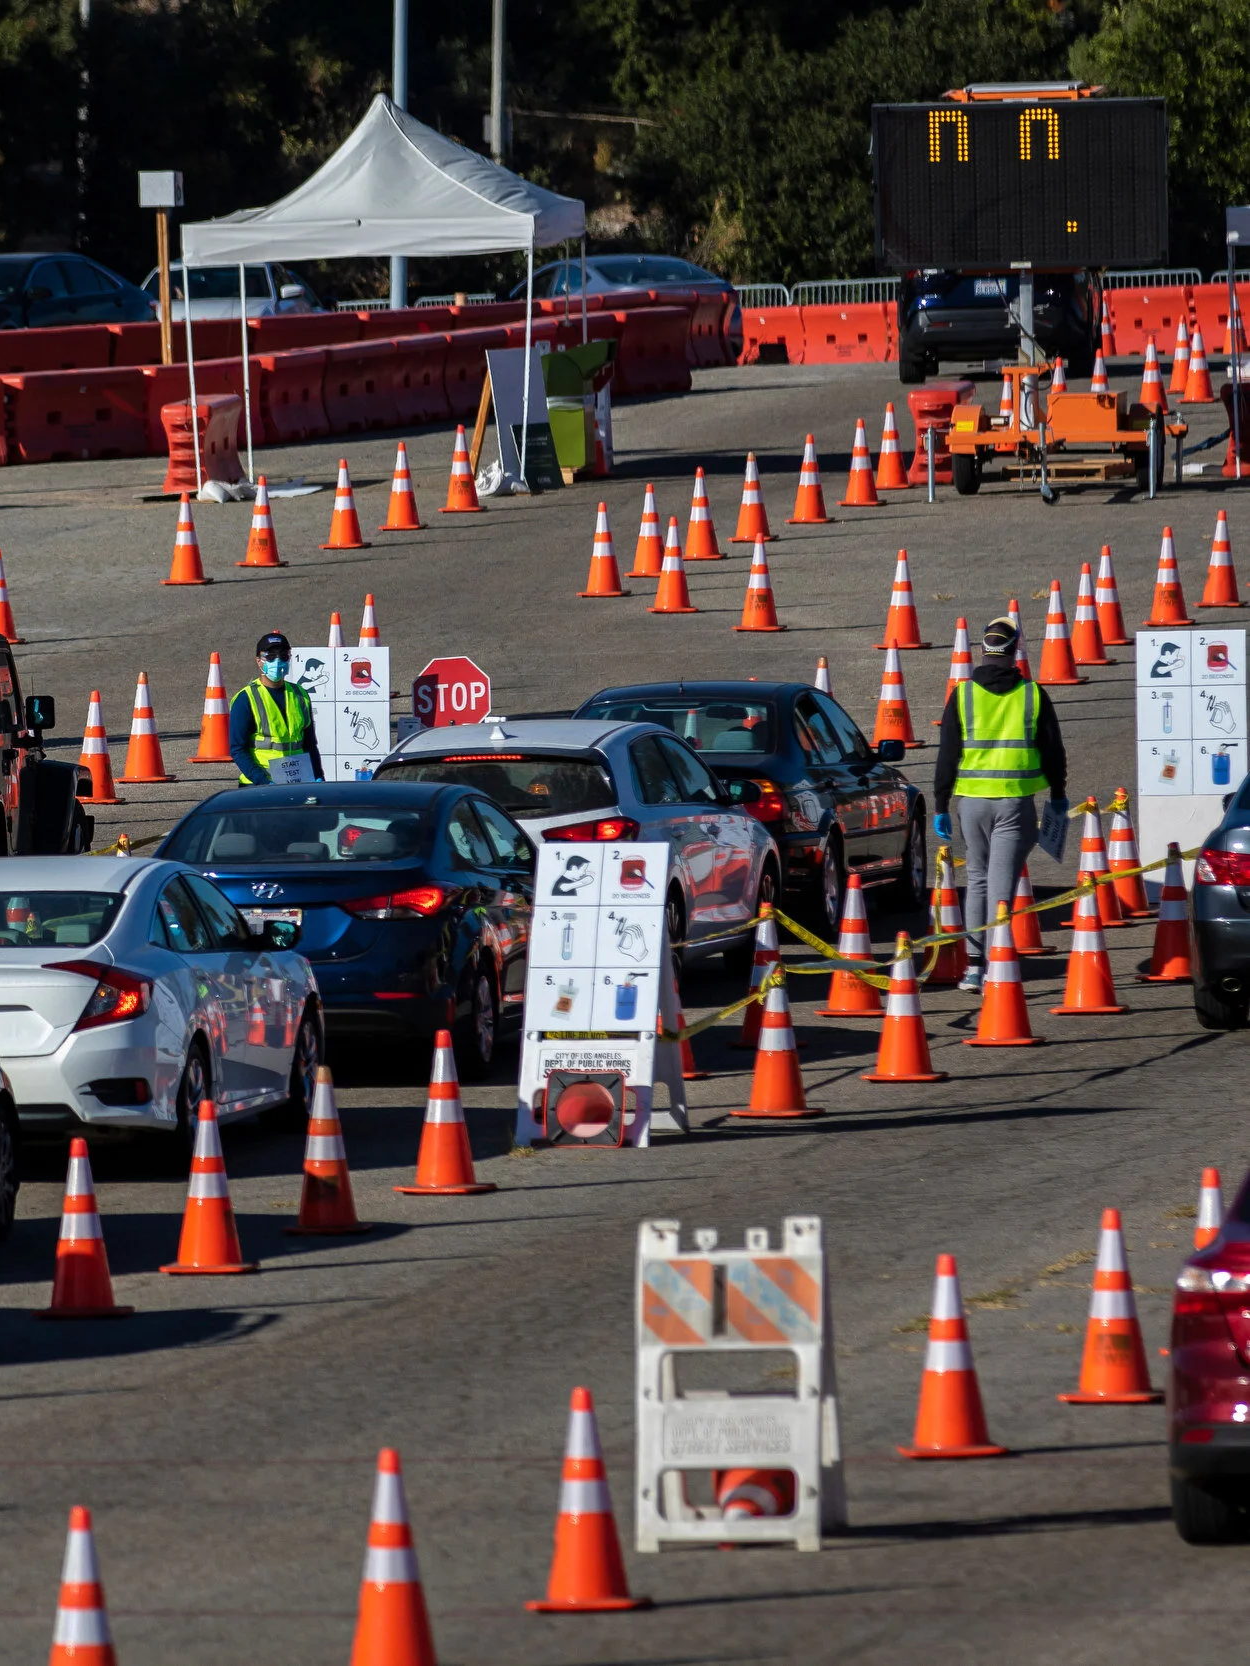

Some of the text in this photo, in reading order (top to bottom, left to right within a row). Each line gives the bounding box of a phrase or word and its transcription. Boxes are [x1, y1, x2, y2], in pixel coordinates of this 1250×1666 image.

[1151, 637, 1209, 647] 1. 2.
[295, 653, 351, 663] 1. 2.
[417, 681, 486, 715] STOP
[1151, 690, 1209, 700] 3. 4.
[343, 706, 352, 715] 4.
[1152, 746, 1210, 756] 5. 6.
[281, 760, 300, 768] START
[344, 761, 353, 770] 6.
[285, 769, 300, 777] TEST
[555, 851, 623, 861] 1. 2.
[550, 911, 618, 921] 3. 4.
[546, 975, 614, 985] 5. 6.
[544, 1060, 631, 1068] DEPT. OF PUBLIC WORKS
[755, 1426, 791, 1438] WORKS
[671, 1440, 792, 1454] STREET SERVICES
